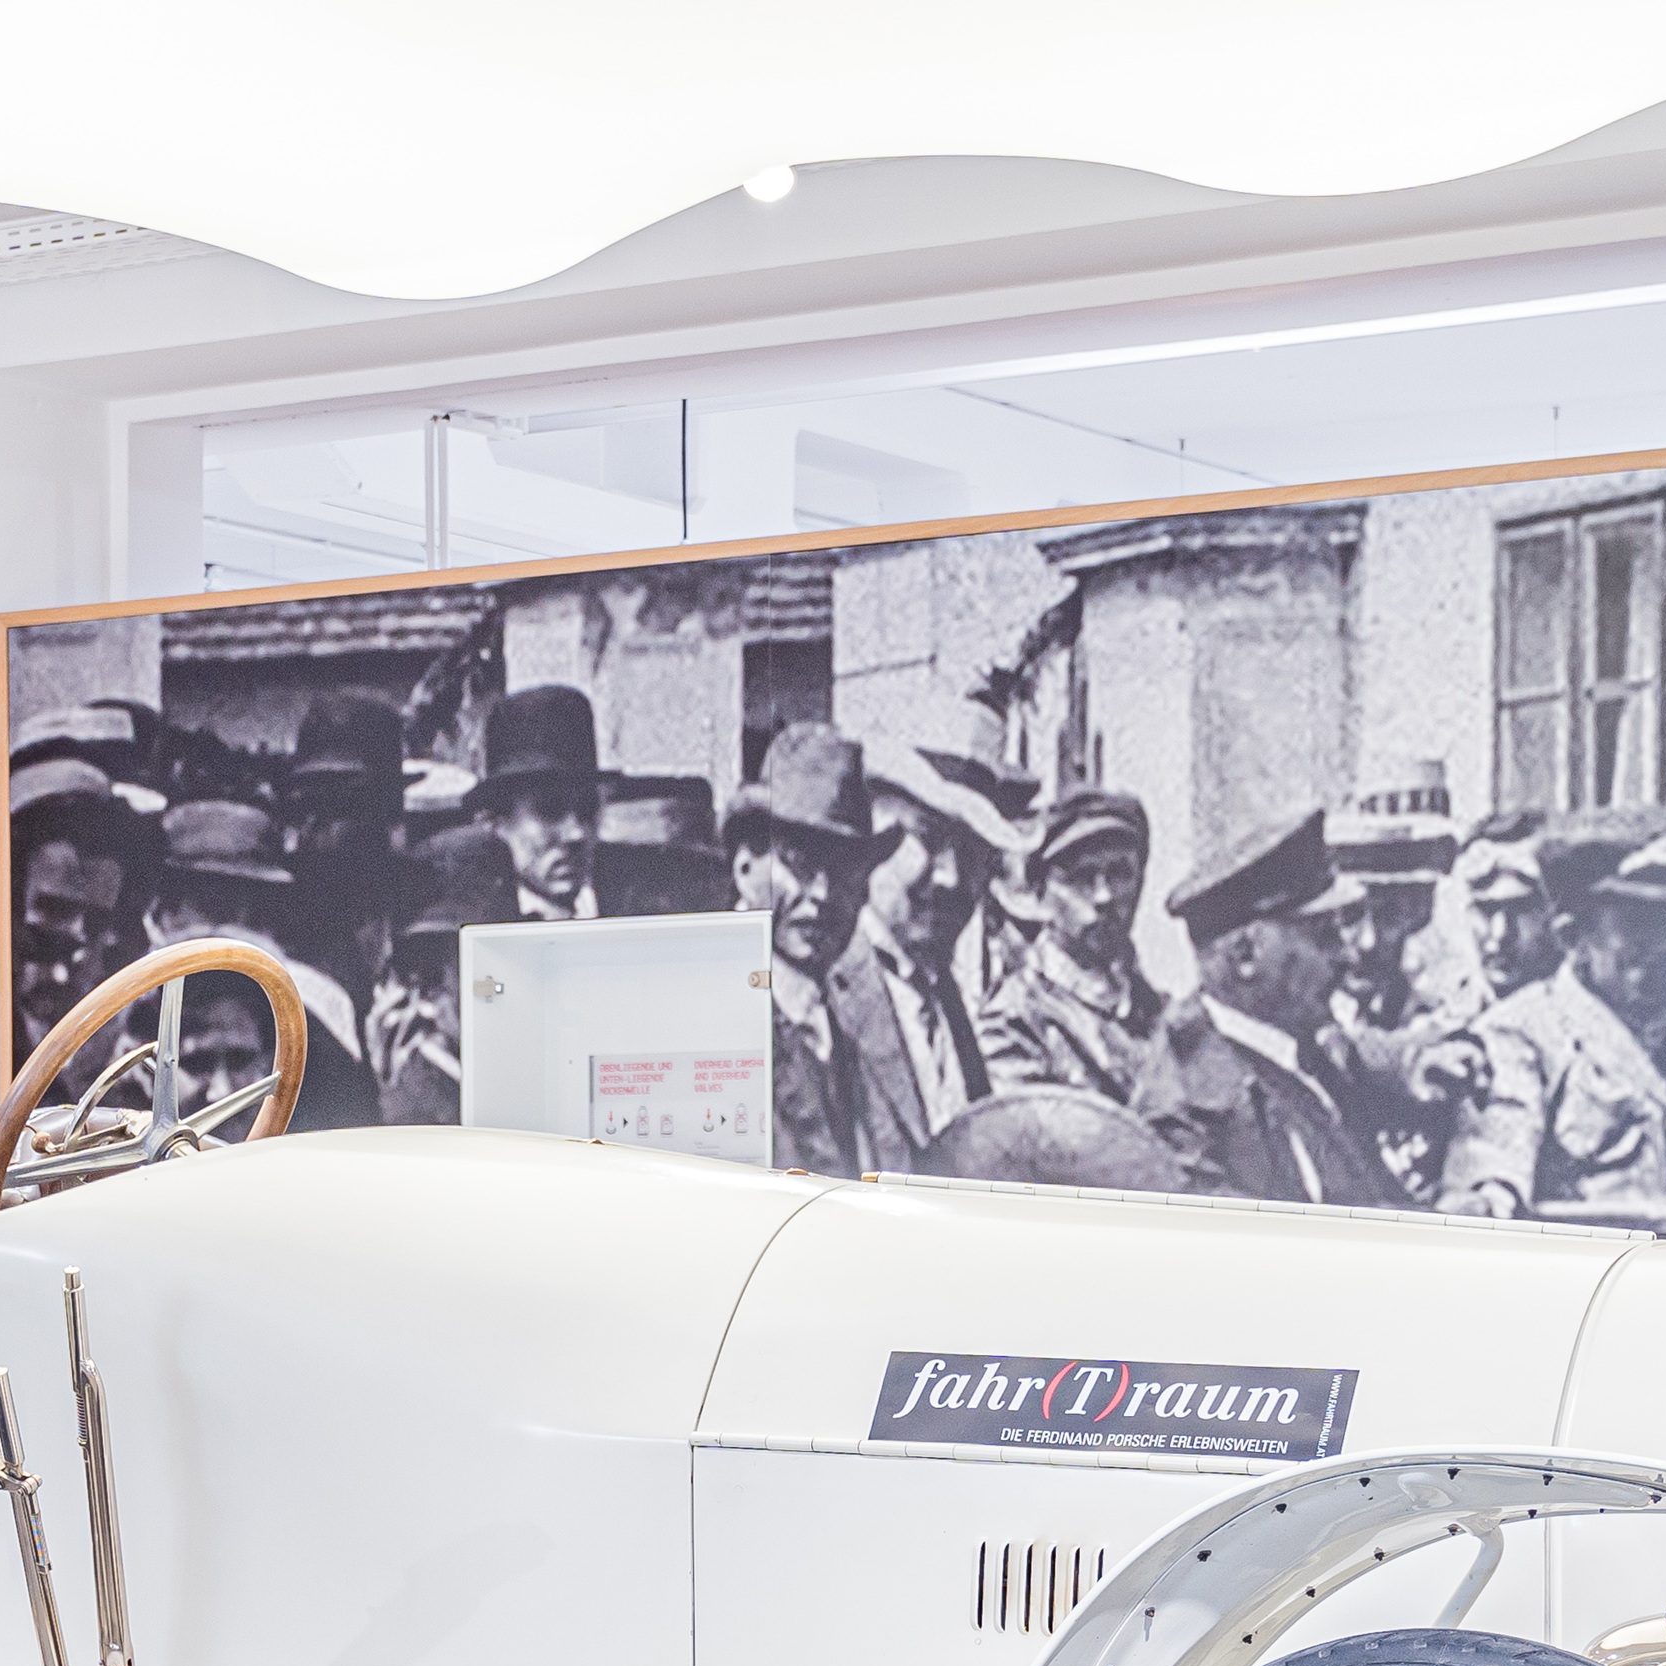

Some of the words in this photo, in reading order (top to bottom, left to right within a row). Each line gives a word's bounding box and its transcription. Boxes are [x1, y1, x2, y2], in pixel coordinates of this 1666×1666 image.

[657, 1061, 674, 1071] UND
[694, 1059, 733, 1070] OVERHEAD
[694, 1071, 709, 1082] AND
[711, 1070, 751, 1081] OVERHEAD
[599, 1085, 652, 1096] NOCKENWELLE
[694, 1083, 723, 1093] VALVES
[892, 1359, 1300, 1425] fahr(T)raum
[1316, 1374, 1343, 1458] WWW.FAHRTRAUM.AT
[1000, 1427, 1023, 1442] DIE
[1025, 1430, 1103, 1447] FERDINAND
[1105, 1433, 1168, 1449] PORSCHE
[1169, 1434, 1289, 1455] ERLEBNISWELTEN
